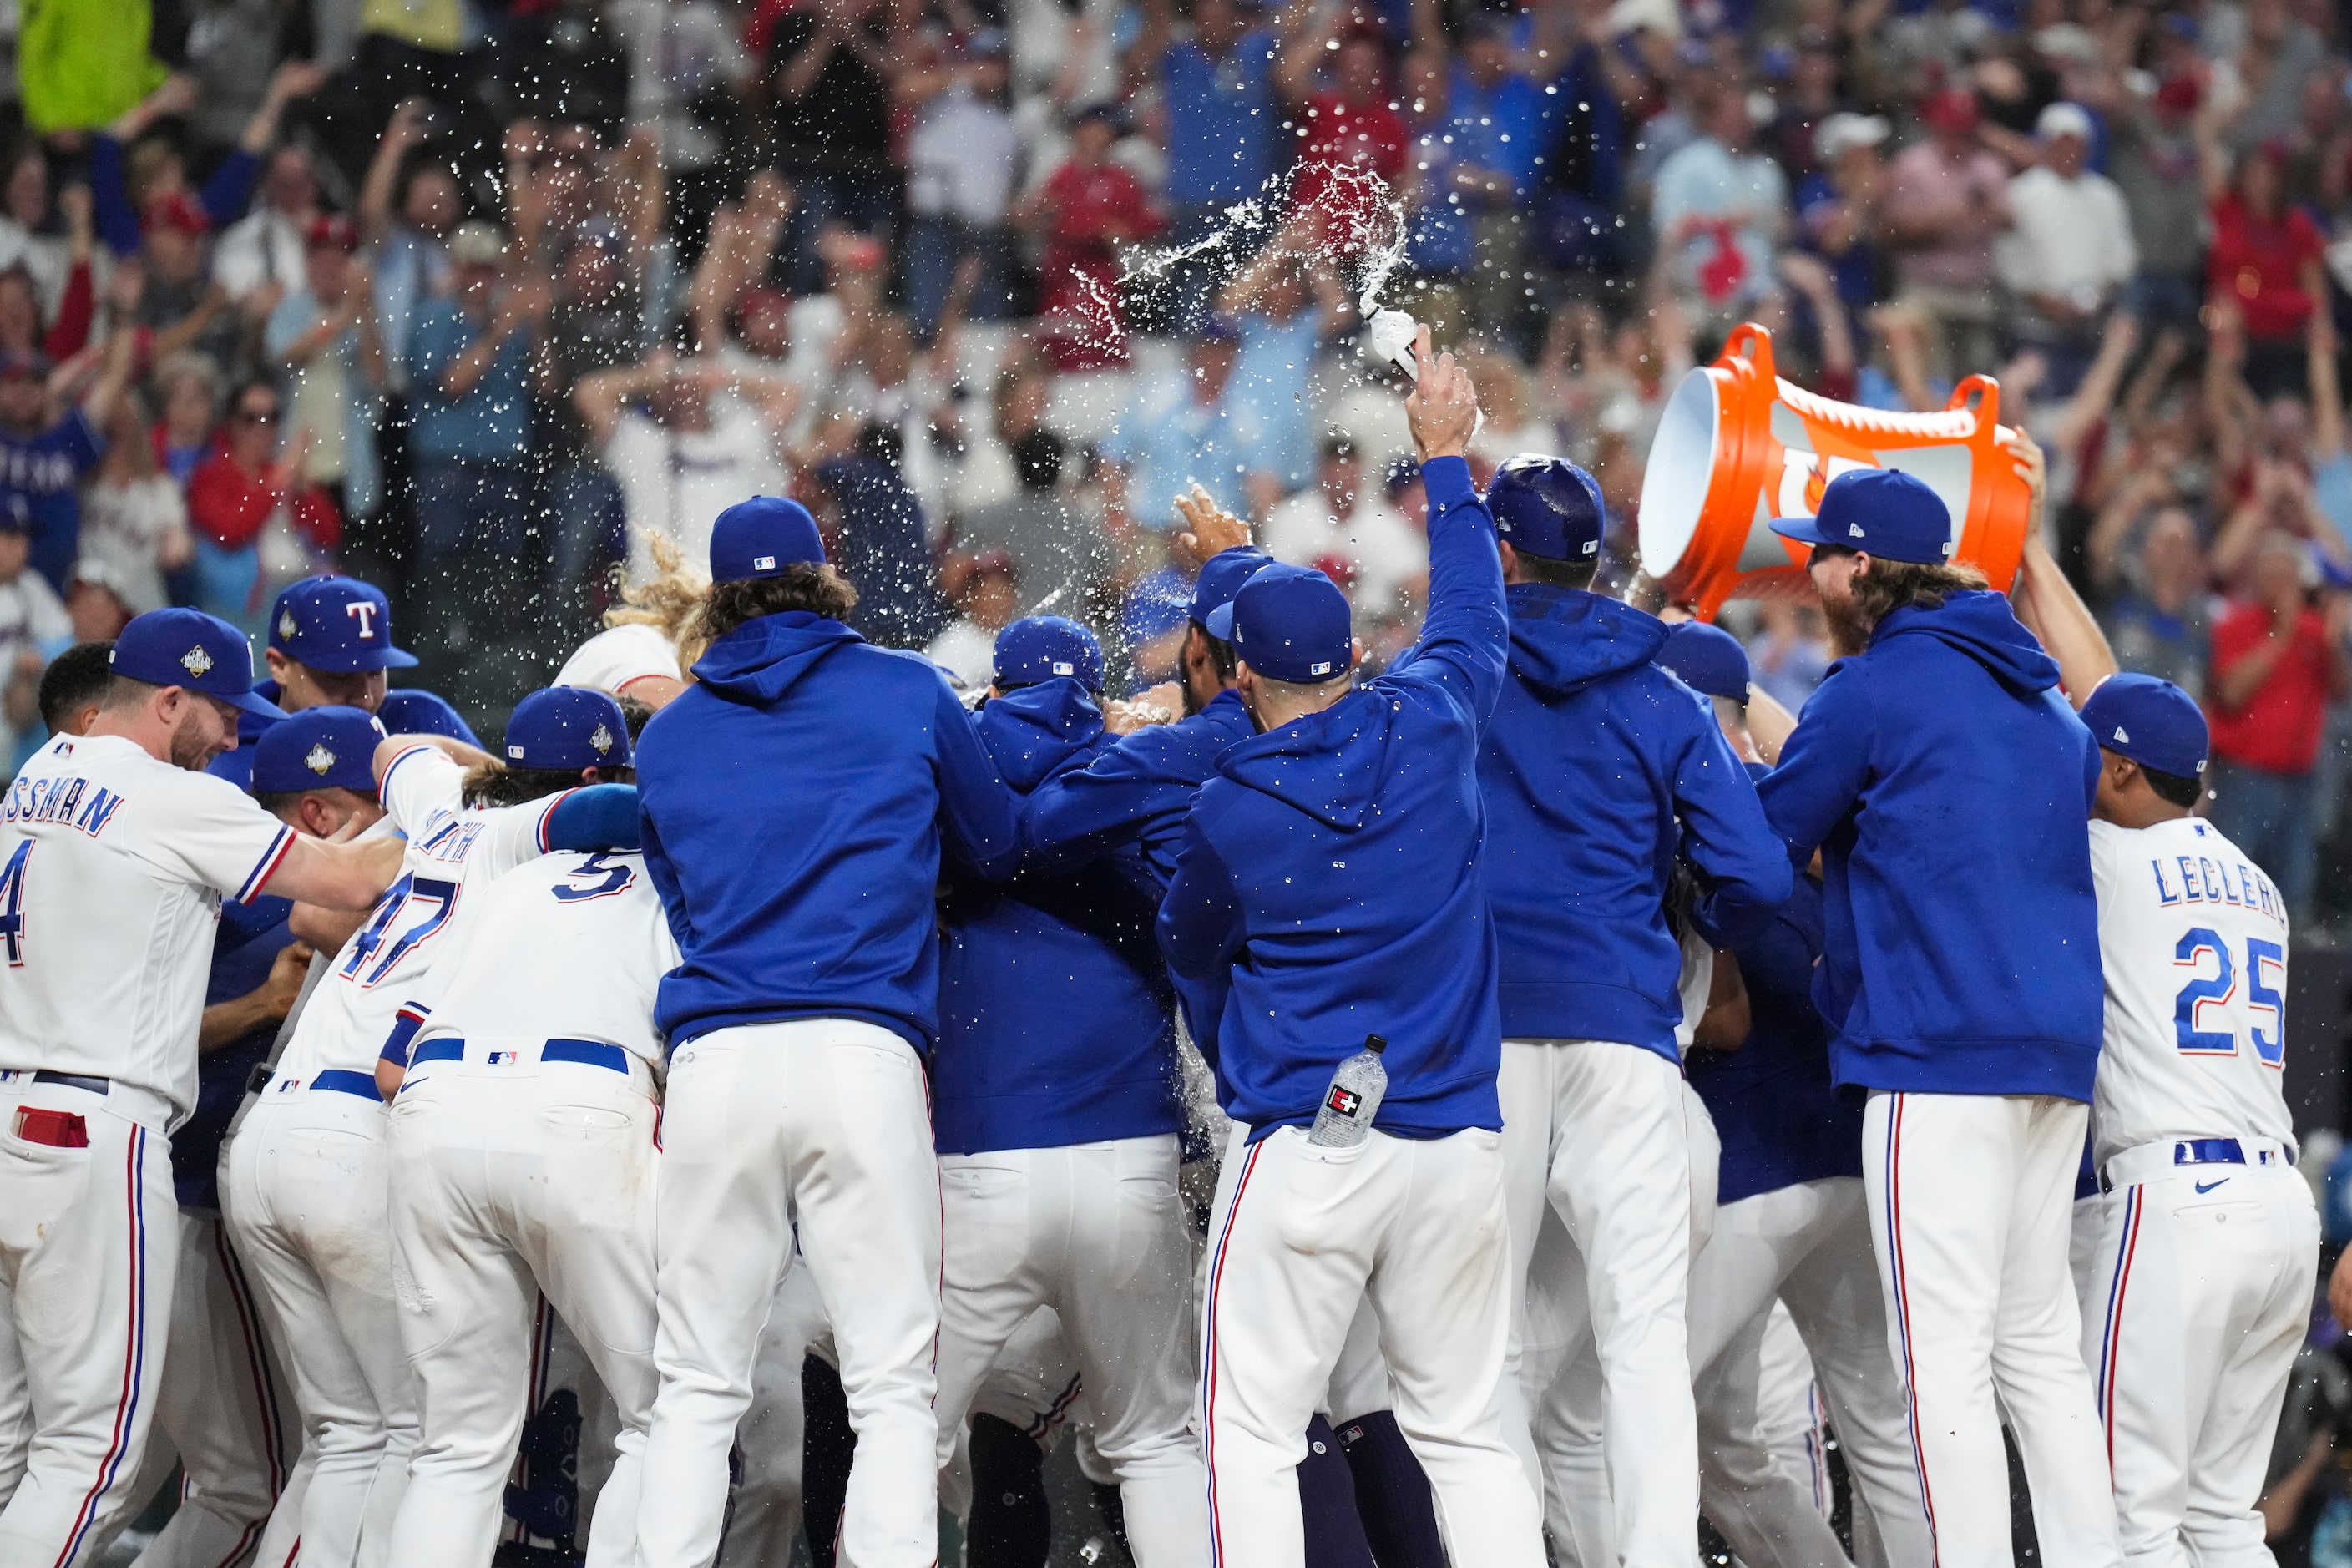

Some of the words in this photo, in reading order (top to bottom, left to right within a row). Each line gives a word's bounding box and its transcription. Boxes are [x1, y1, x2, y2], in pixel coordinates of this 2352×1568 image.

[346, 601, 377, 640] T
[0, 776, 124, 837] SSMAN
[551, 852, 637, 903] 5
[339, 869, 461, 988] 47
[2173, 927, 2286, 1070] 25
